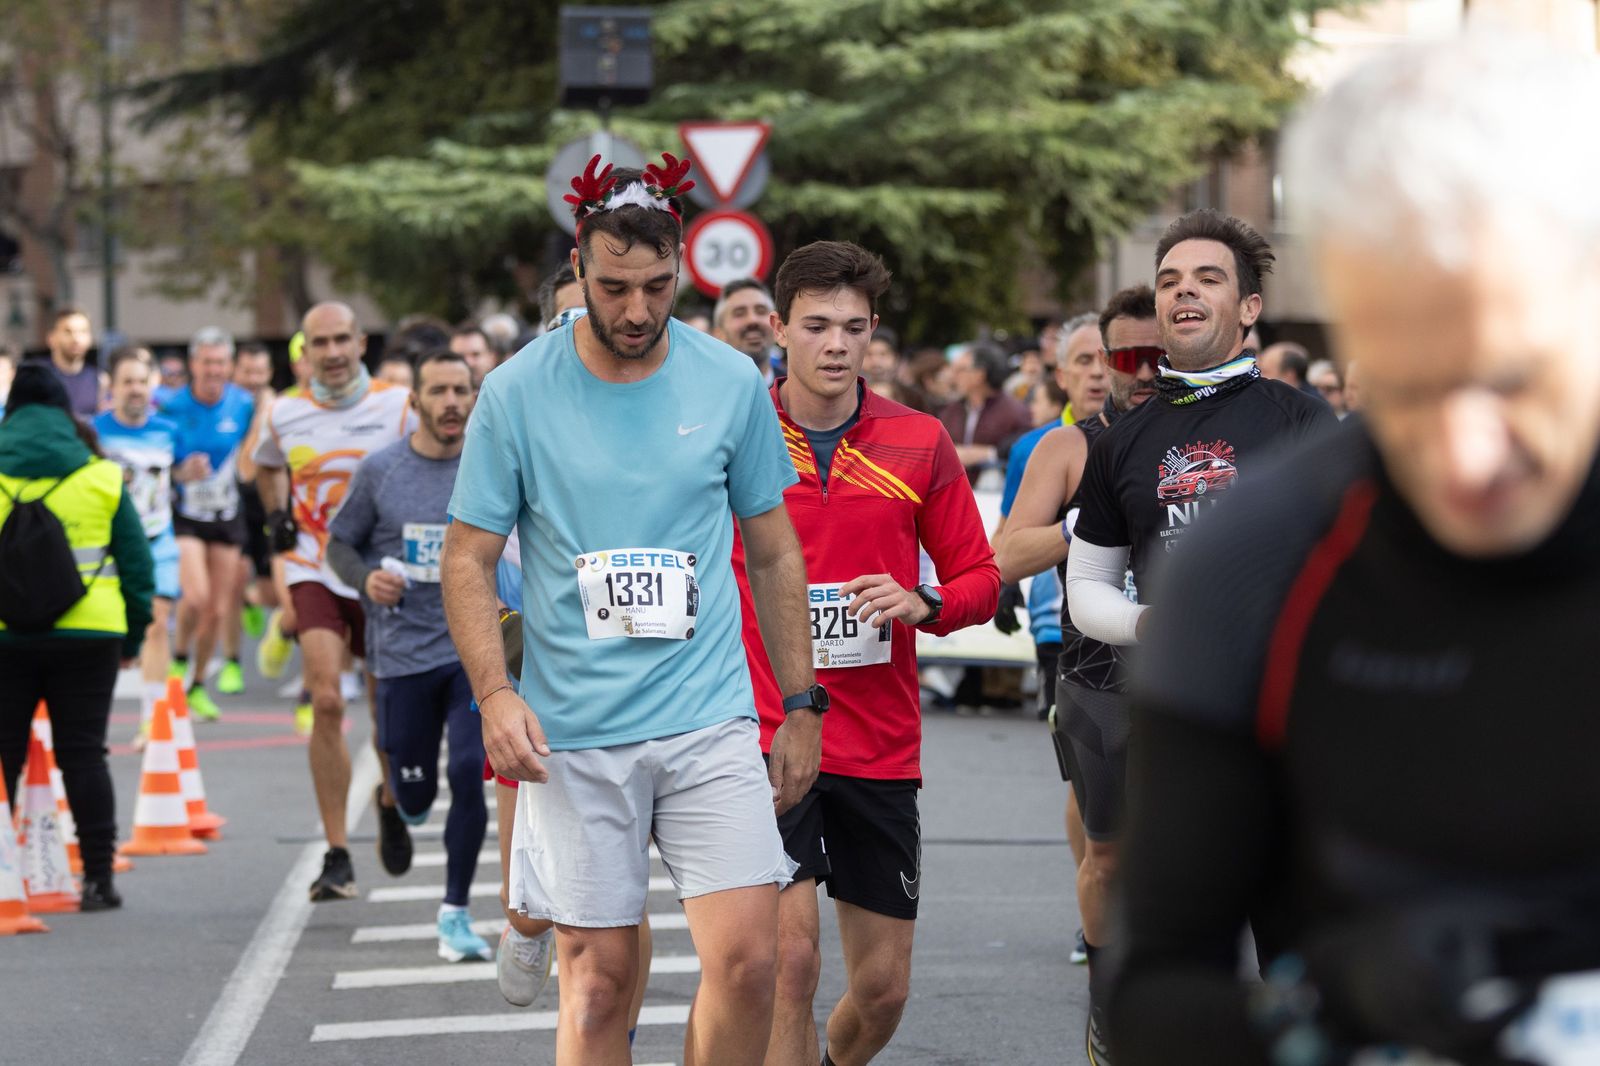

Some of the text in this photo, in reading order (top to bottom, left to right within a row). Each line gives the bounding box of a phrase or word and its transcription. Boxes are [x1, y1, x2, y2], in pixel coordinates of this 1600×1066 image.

[704, 239, 751, 269] 30
[611, 553, 685, 569] SETEL
[605, 572, 663, 606] 1331
[820, 639, 844, 647] DARIO
